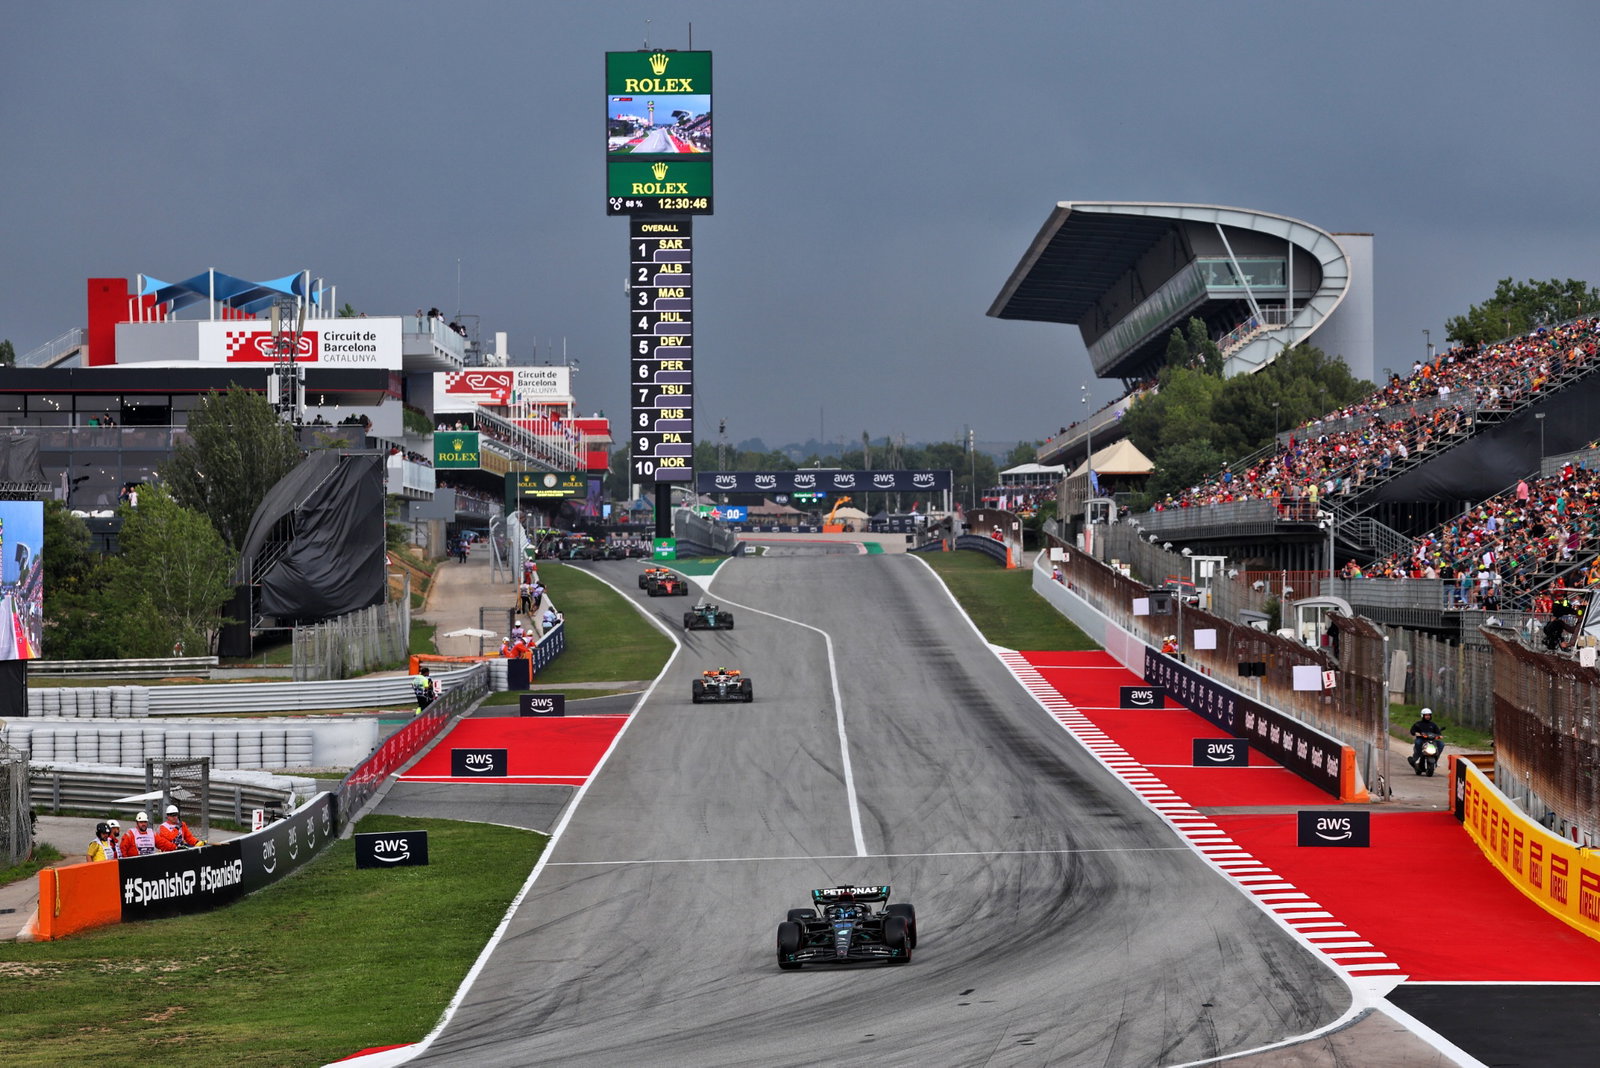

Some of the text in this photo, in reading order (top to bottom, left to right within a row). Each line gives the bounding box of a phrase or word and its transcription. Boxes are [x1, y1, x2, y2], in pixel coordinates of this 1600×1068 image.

[625, 78, 693, 92] ROLEX
[632, 183, 688, 194] ROLEX
[658, 198, 708, 208] 12:30:46
[638, 240, 682, 257] 1 SAR
[638, 264, 682, 281] 2 ALB
[638, 288, 684, 306] 3 MAG
[638, 312, 683, 330] 4 HUL
[324, 331, 376, 340] Circuit de
[324, 343, 376, 352] Barcelona
[639, 337, 683, 354] 5 DEV
[639, 361, 683, 378] 6 PER
[639, 385, 683, 402] 7 TSU
[640, 410, 684, 426] 8 RUS
[640, 434, 681, 450] 9 PIA
[440, 453, 477, 461] ROLEX
[636, 458, 684, 475] 10 NOR
[716, 473, 934, 483] aws aws aws aws aws aws
[1131, 690, 1153, 699] aws
[531, 698, 553, 707] aws
[1208, 744, 1234, 754] aws
[466, 754, 493, 763] aws
[1316, 818, 1350, 830] aws
[375, 839, 408, 852] aws
[124, 859, 242, 906] #SpanishGP #SpanishGP
[1550, 852, 1568, 906] PIRELLI
